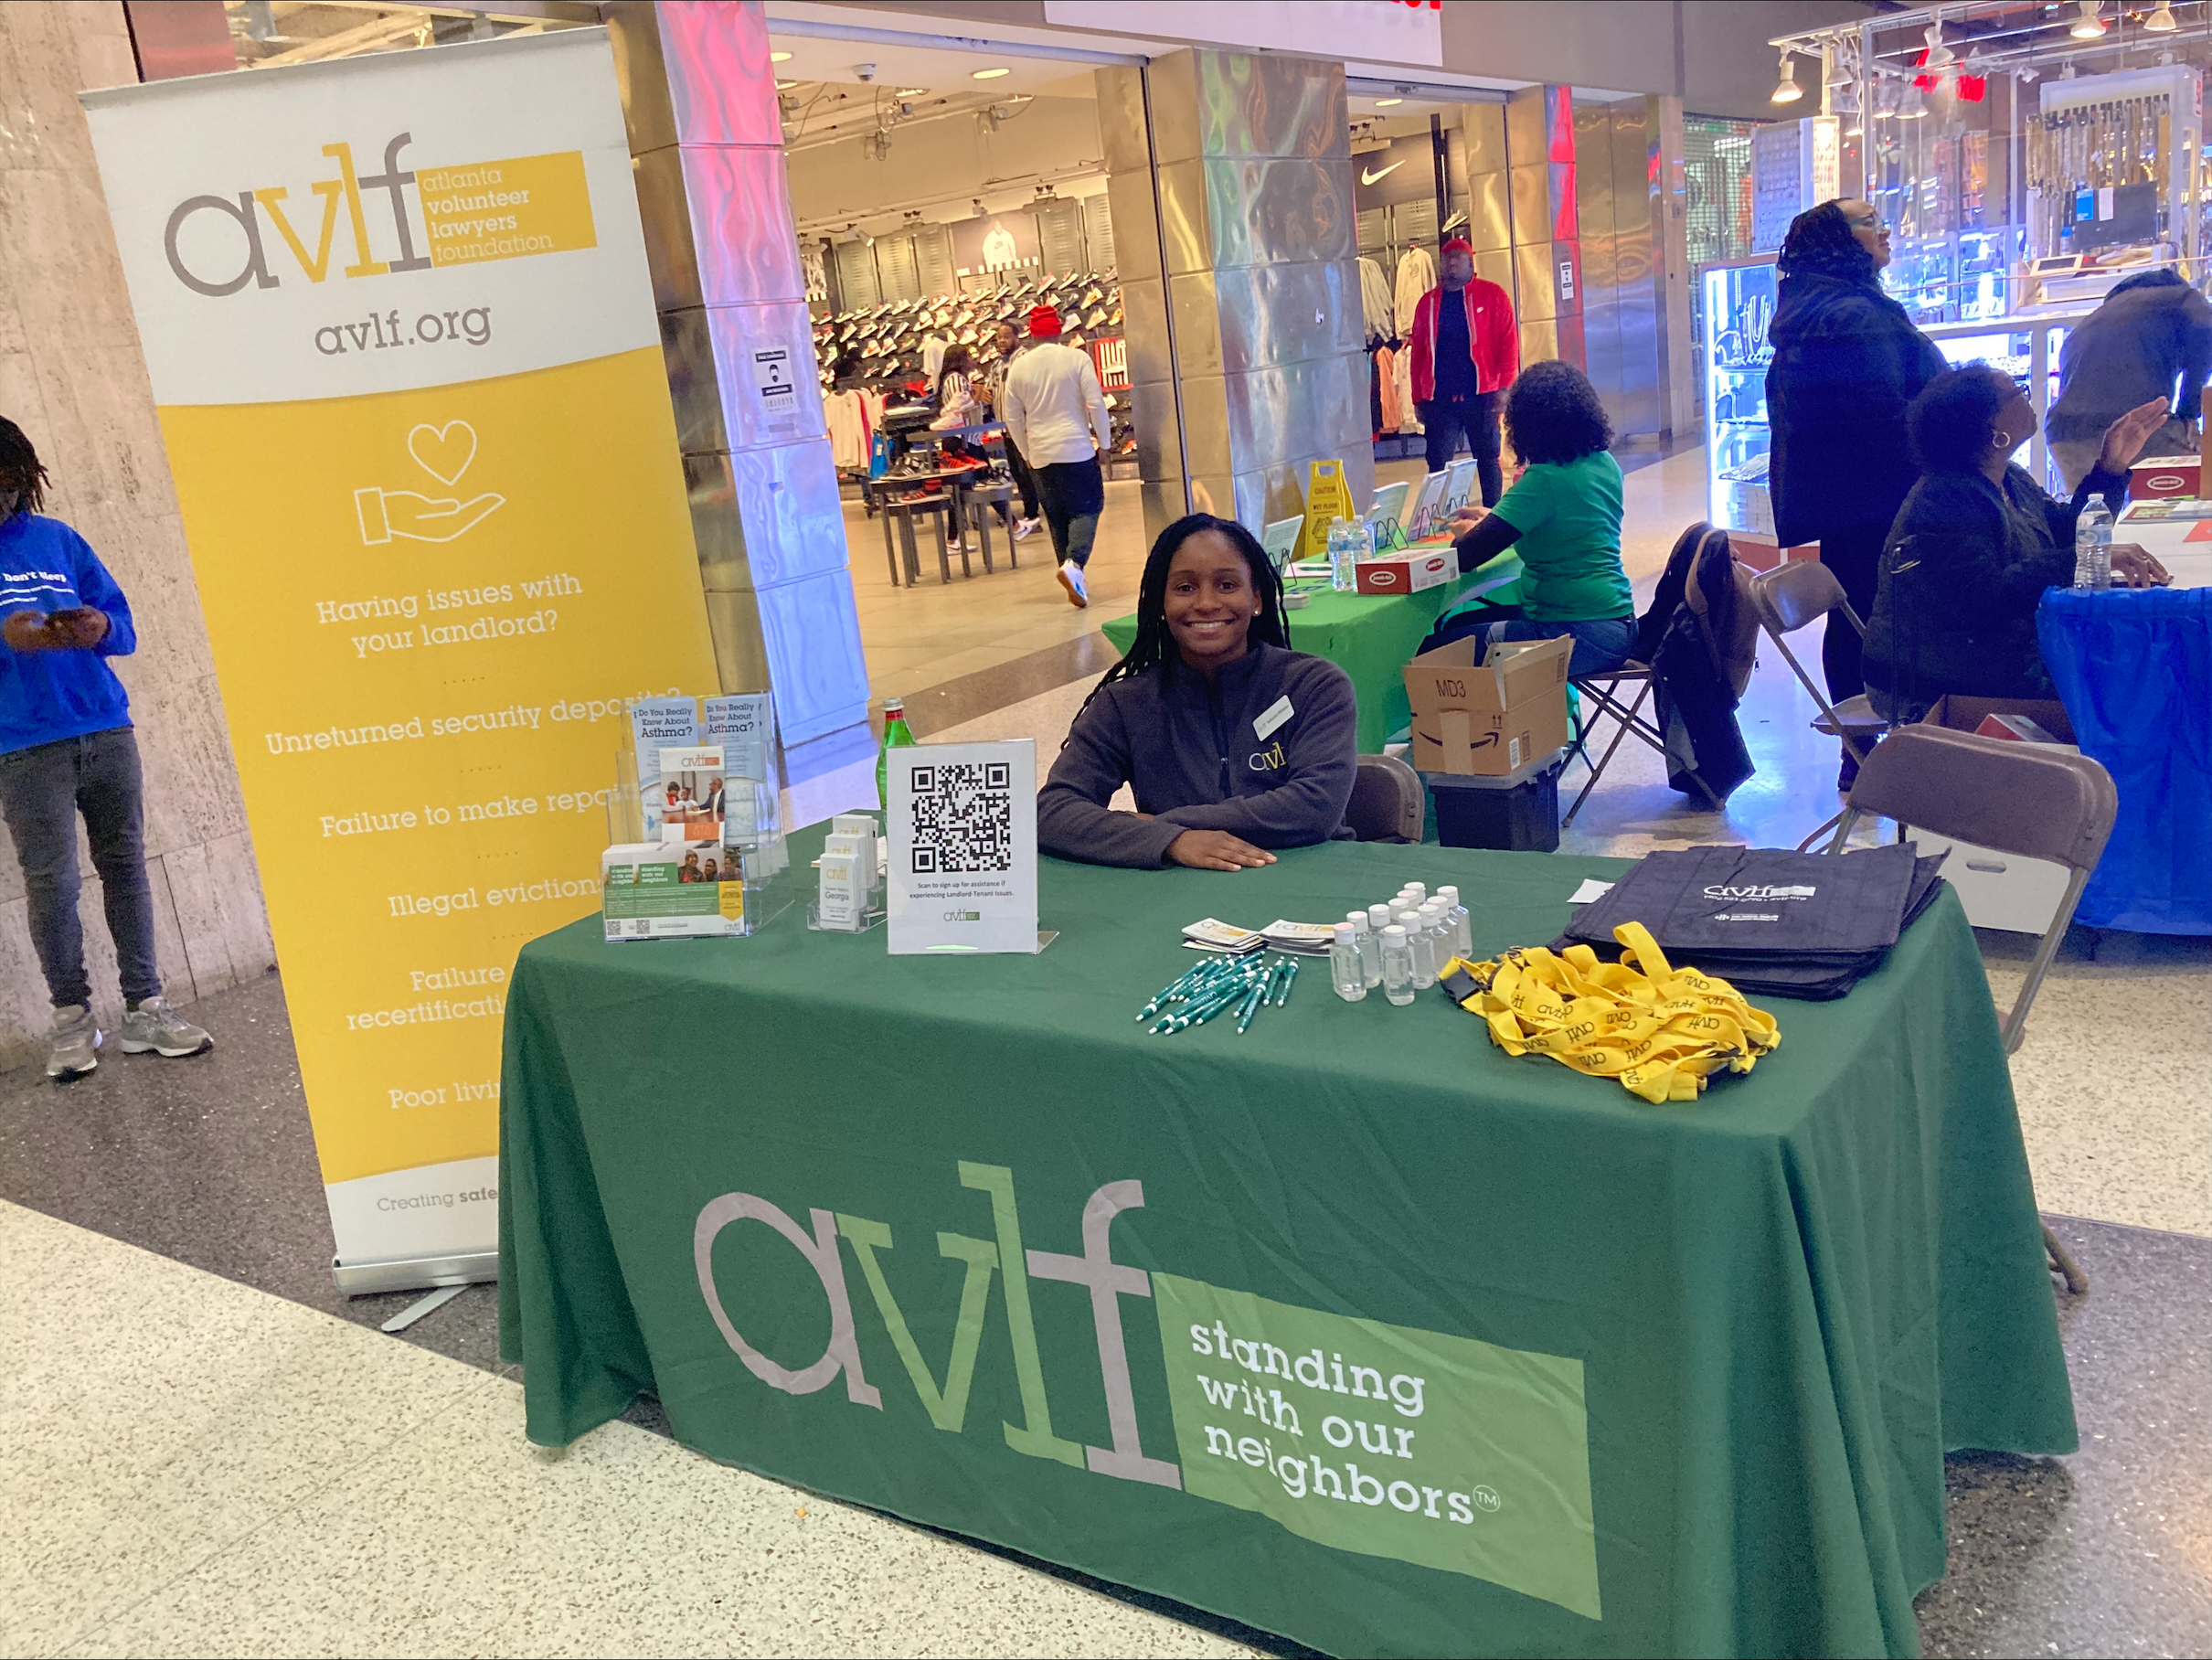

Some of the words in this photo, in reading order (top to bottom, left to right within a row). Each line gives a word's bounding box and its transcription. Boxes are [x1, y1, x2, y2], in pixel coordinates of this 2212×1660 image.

[423, 167, 503, 192] atlanta
[165, 132, 431, 296] avlf
[427, 186, 530, 216] volunteer
[431, 212, 517, 239] lawyers
[436, 233, 553, 262] foundation
[314, 306, 491, 356] avlf.org
[1313, 485, 1336, 495] CAUTION
[1323, 502, 1337, 510] FLOOR
[316, 593, 419, 624] Having
[428, 582, 513, 610] issues
[521, 573, 582, 599] with
[352, 631, 414, 659] your
[423, 610, 558, 646] landlord?
[1436, 679, 1466, 698] MD3
[639, 708, 649, 718] Do
[649, 708, 664, 717] You
[665, 708, 692, 717] Really
[707, 705, 714, 713] Do
[728, 703, 754, 712] Really
[708, 714, 725, 722] Know
[265, 716, 424, 754] Unreturned
[432, 700, 540, 738] security
[642, 726, 693, 738] Asthma?
[708, 721, 754, 734] Asthma?
[1249, 741, 1286, 771] avl
[321, 805, 417, 837] Failure
[424, 802, 451, 825] to
[458, 793, 538, 822] make
[388, 883, 480, 917] Illegal
[825, 891, 849, 901] Georgia
[1704, 885, 1774, 898] avlf
[943, 909, 966, 921] avlf
[410, 965, 505, 992] Failure
[388, 1088, 446, 1109] Poor
[377, 1191, 455, 1211] Creating
[694, 1160, 1183, 1491] avlf
[1190, 1318, 1425, 1417] standing
[1196, 1372, 1303, 1436] with
[1322, 1414, 1415, 1460] our
